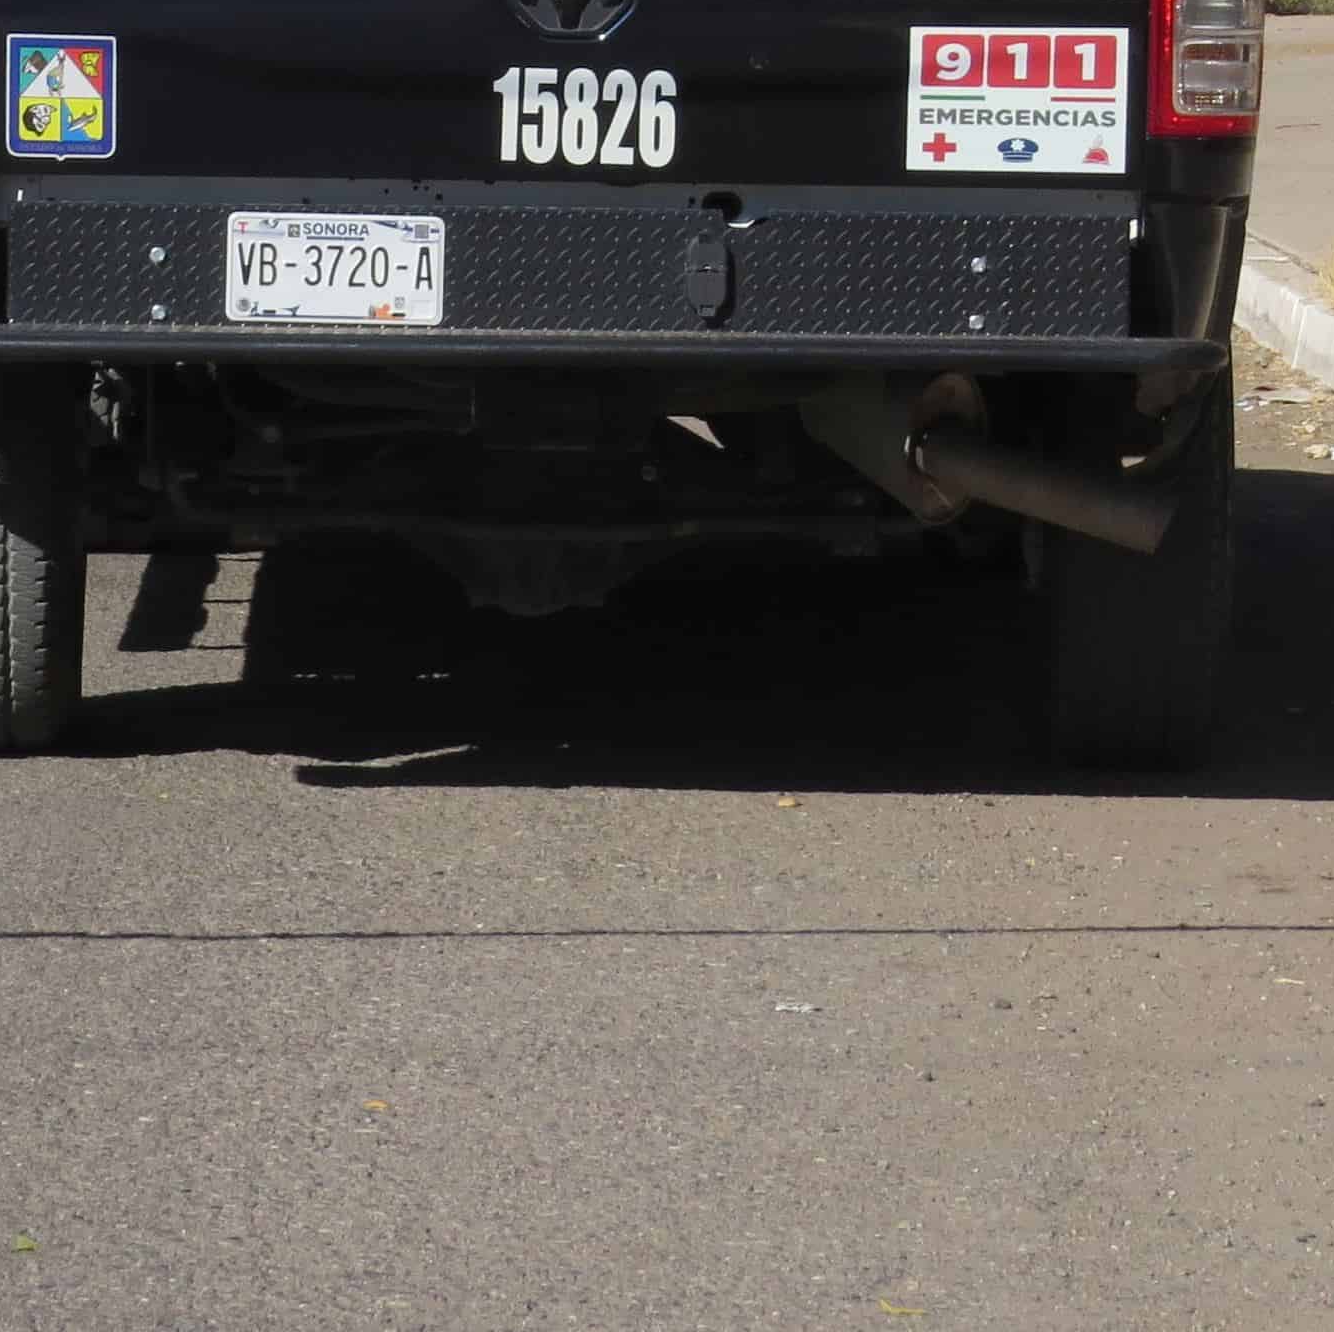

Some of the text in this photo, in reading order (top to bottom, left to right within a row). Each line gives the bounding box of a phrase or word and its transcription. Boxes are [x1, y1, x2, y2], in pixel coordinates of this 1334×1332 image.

[935, 44, 1099, 82] 911
[493, 67, 677, 167] 15826
[919, 108, 1117, 127] EMERGENCIAS
[302, 222, 370, 237] SONORA
[238, 242, 434, 291] VB-3720-A
